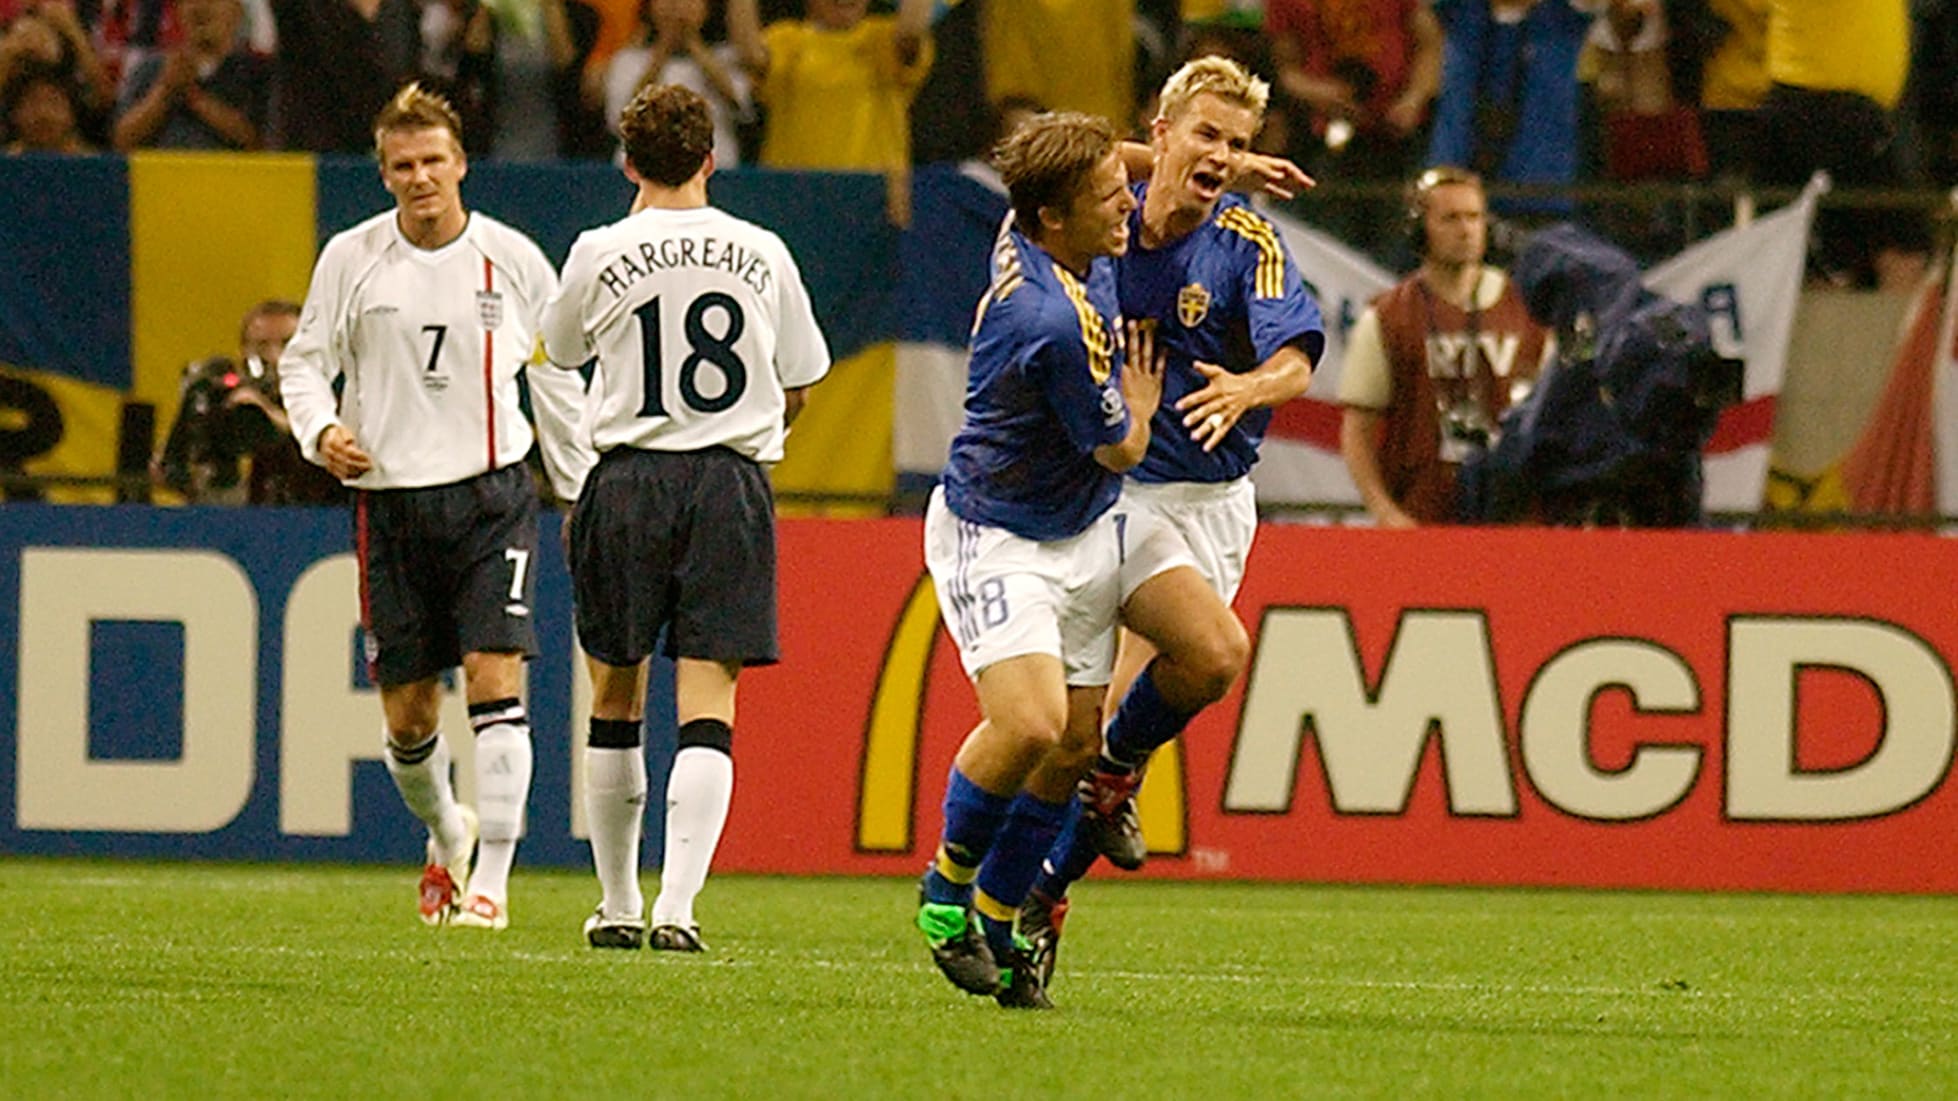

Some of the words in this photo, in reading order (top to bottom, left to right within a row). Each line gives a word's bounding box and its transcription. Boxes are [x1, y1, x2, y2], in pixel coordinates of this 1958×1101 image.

[600, 237, 773, 298] HARGREAVES
[421, 324, 448, 372] 7
[632, 291, 748, 417] 18
[505, 548, 529, 600] 7
[979, 577, 1010, 629] 8
[1222, 605, 1957, 824] McD
